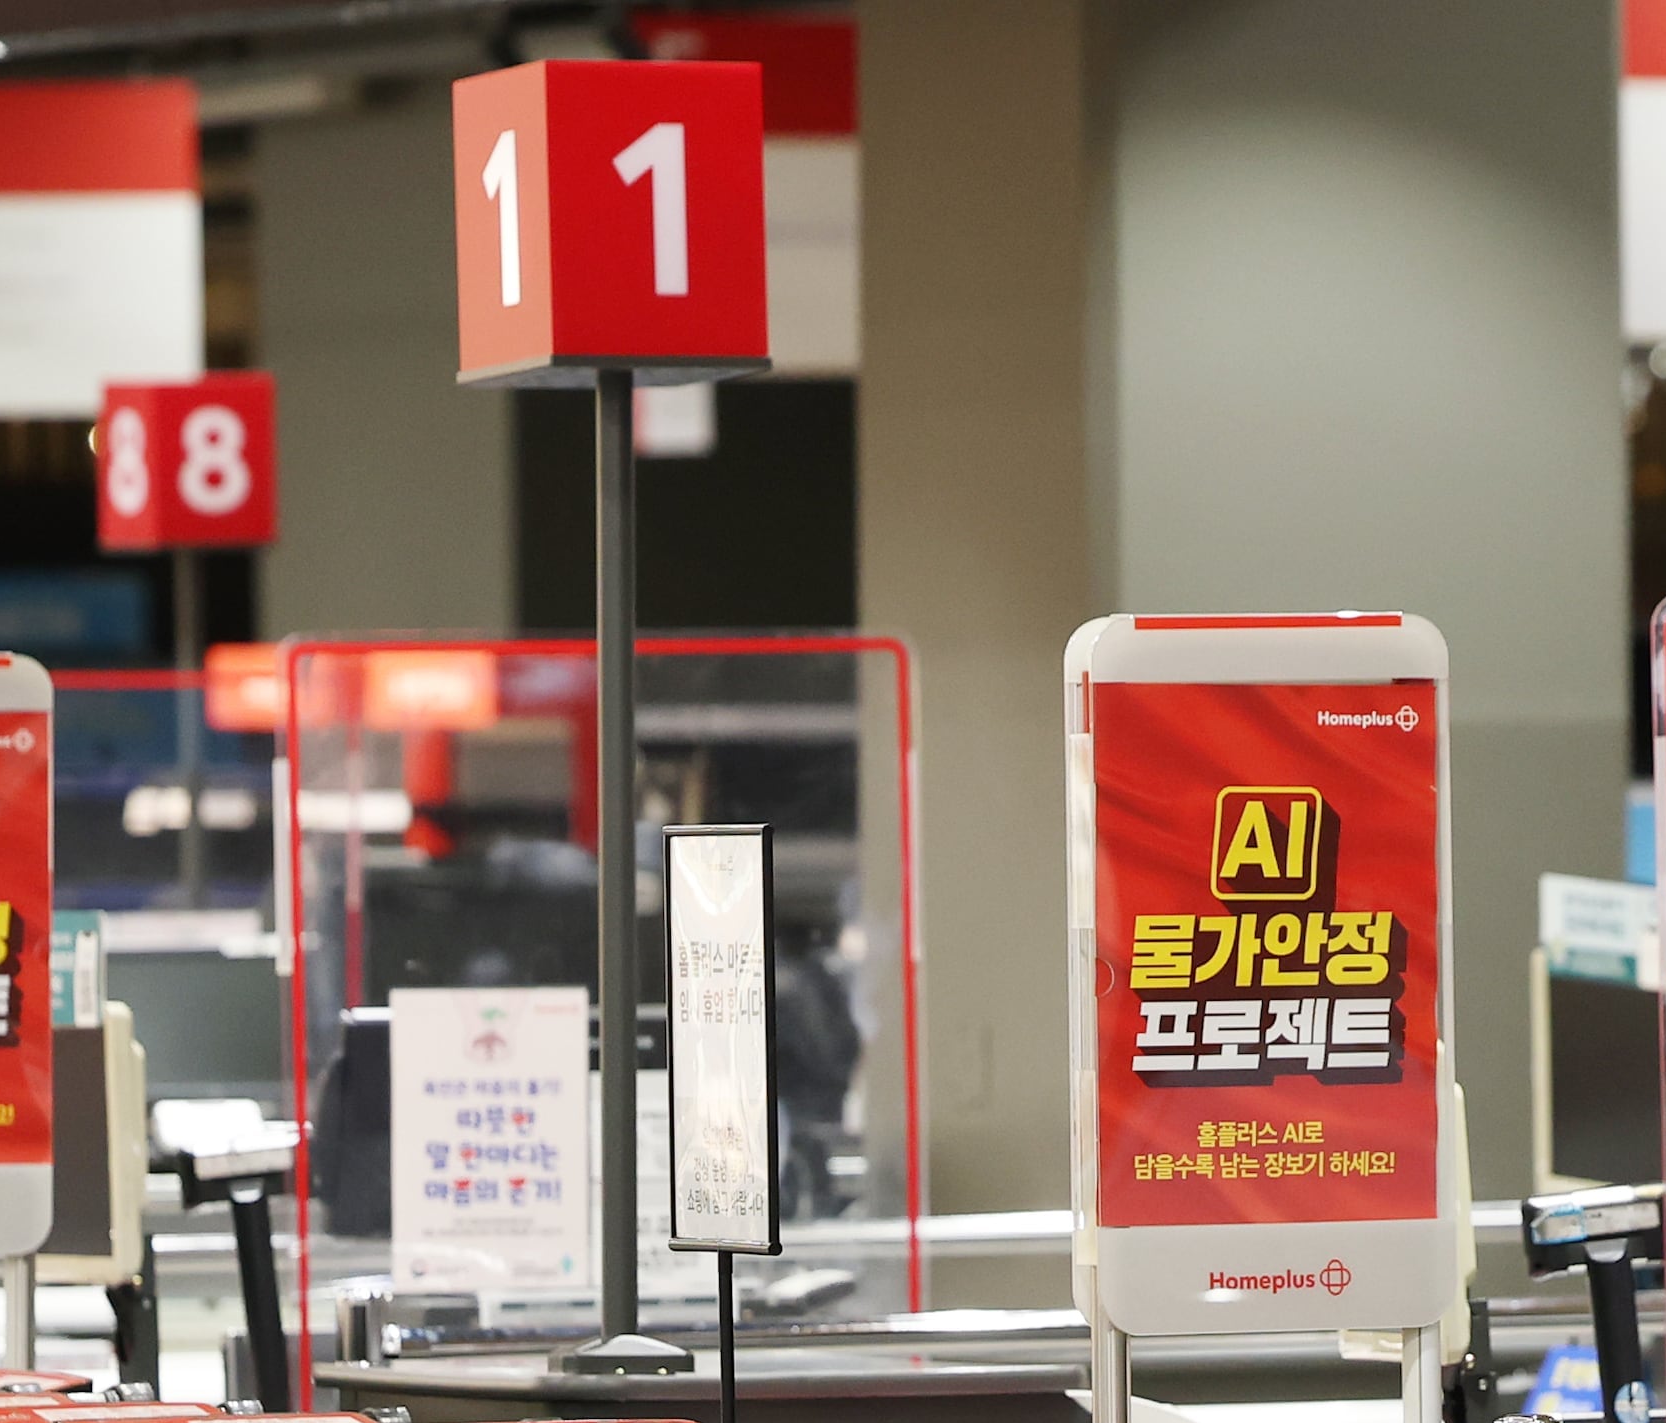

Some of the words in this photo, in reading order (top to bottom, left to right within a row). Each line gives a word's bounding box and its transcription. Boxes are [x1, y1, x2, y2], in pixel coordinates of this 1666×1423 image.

[482, 129, 520, 307] 1
[612, 122, 688, 296] 1
[107, 408, 148, 517] 8
[178, 405, 251, 515] 8
[1317, 709, 1393, 730] Homeplus
[1219, 800, 1308, 879] AI
[1129, 911, 1393, 990] 물가안정
[703, 988, 724, 1025] 휴업
[1132, 997, 1393, 1072] 프로젝트
[1134, 1152, 1215, 1181] 담을수록
[1219, 1151, 1260, 1179] 남는
[1264, 1150, 1325, 1178] 장보기
[1329, 1149, 1396, 1177] 하세요!
[1197, 1121, 1278, 1148] 홈플러스
[1282, 1121, 1324, 1146] AI로
[1209, 1268, 1316, 1294] Homeplus
